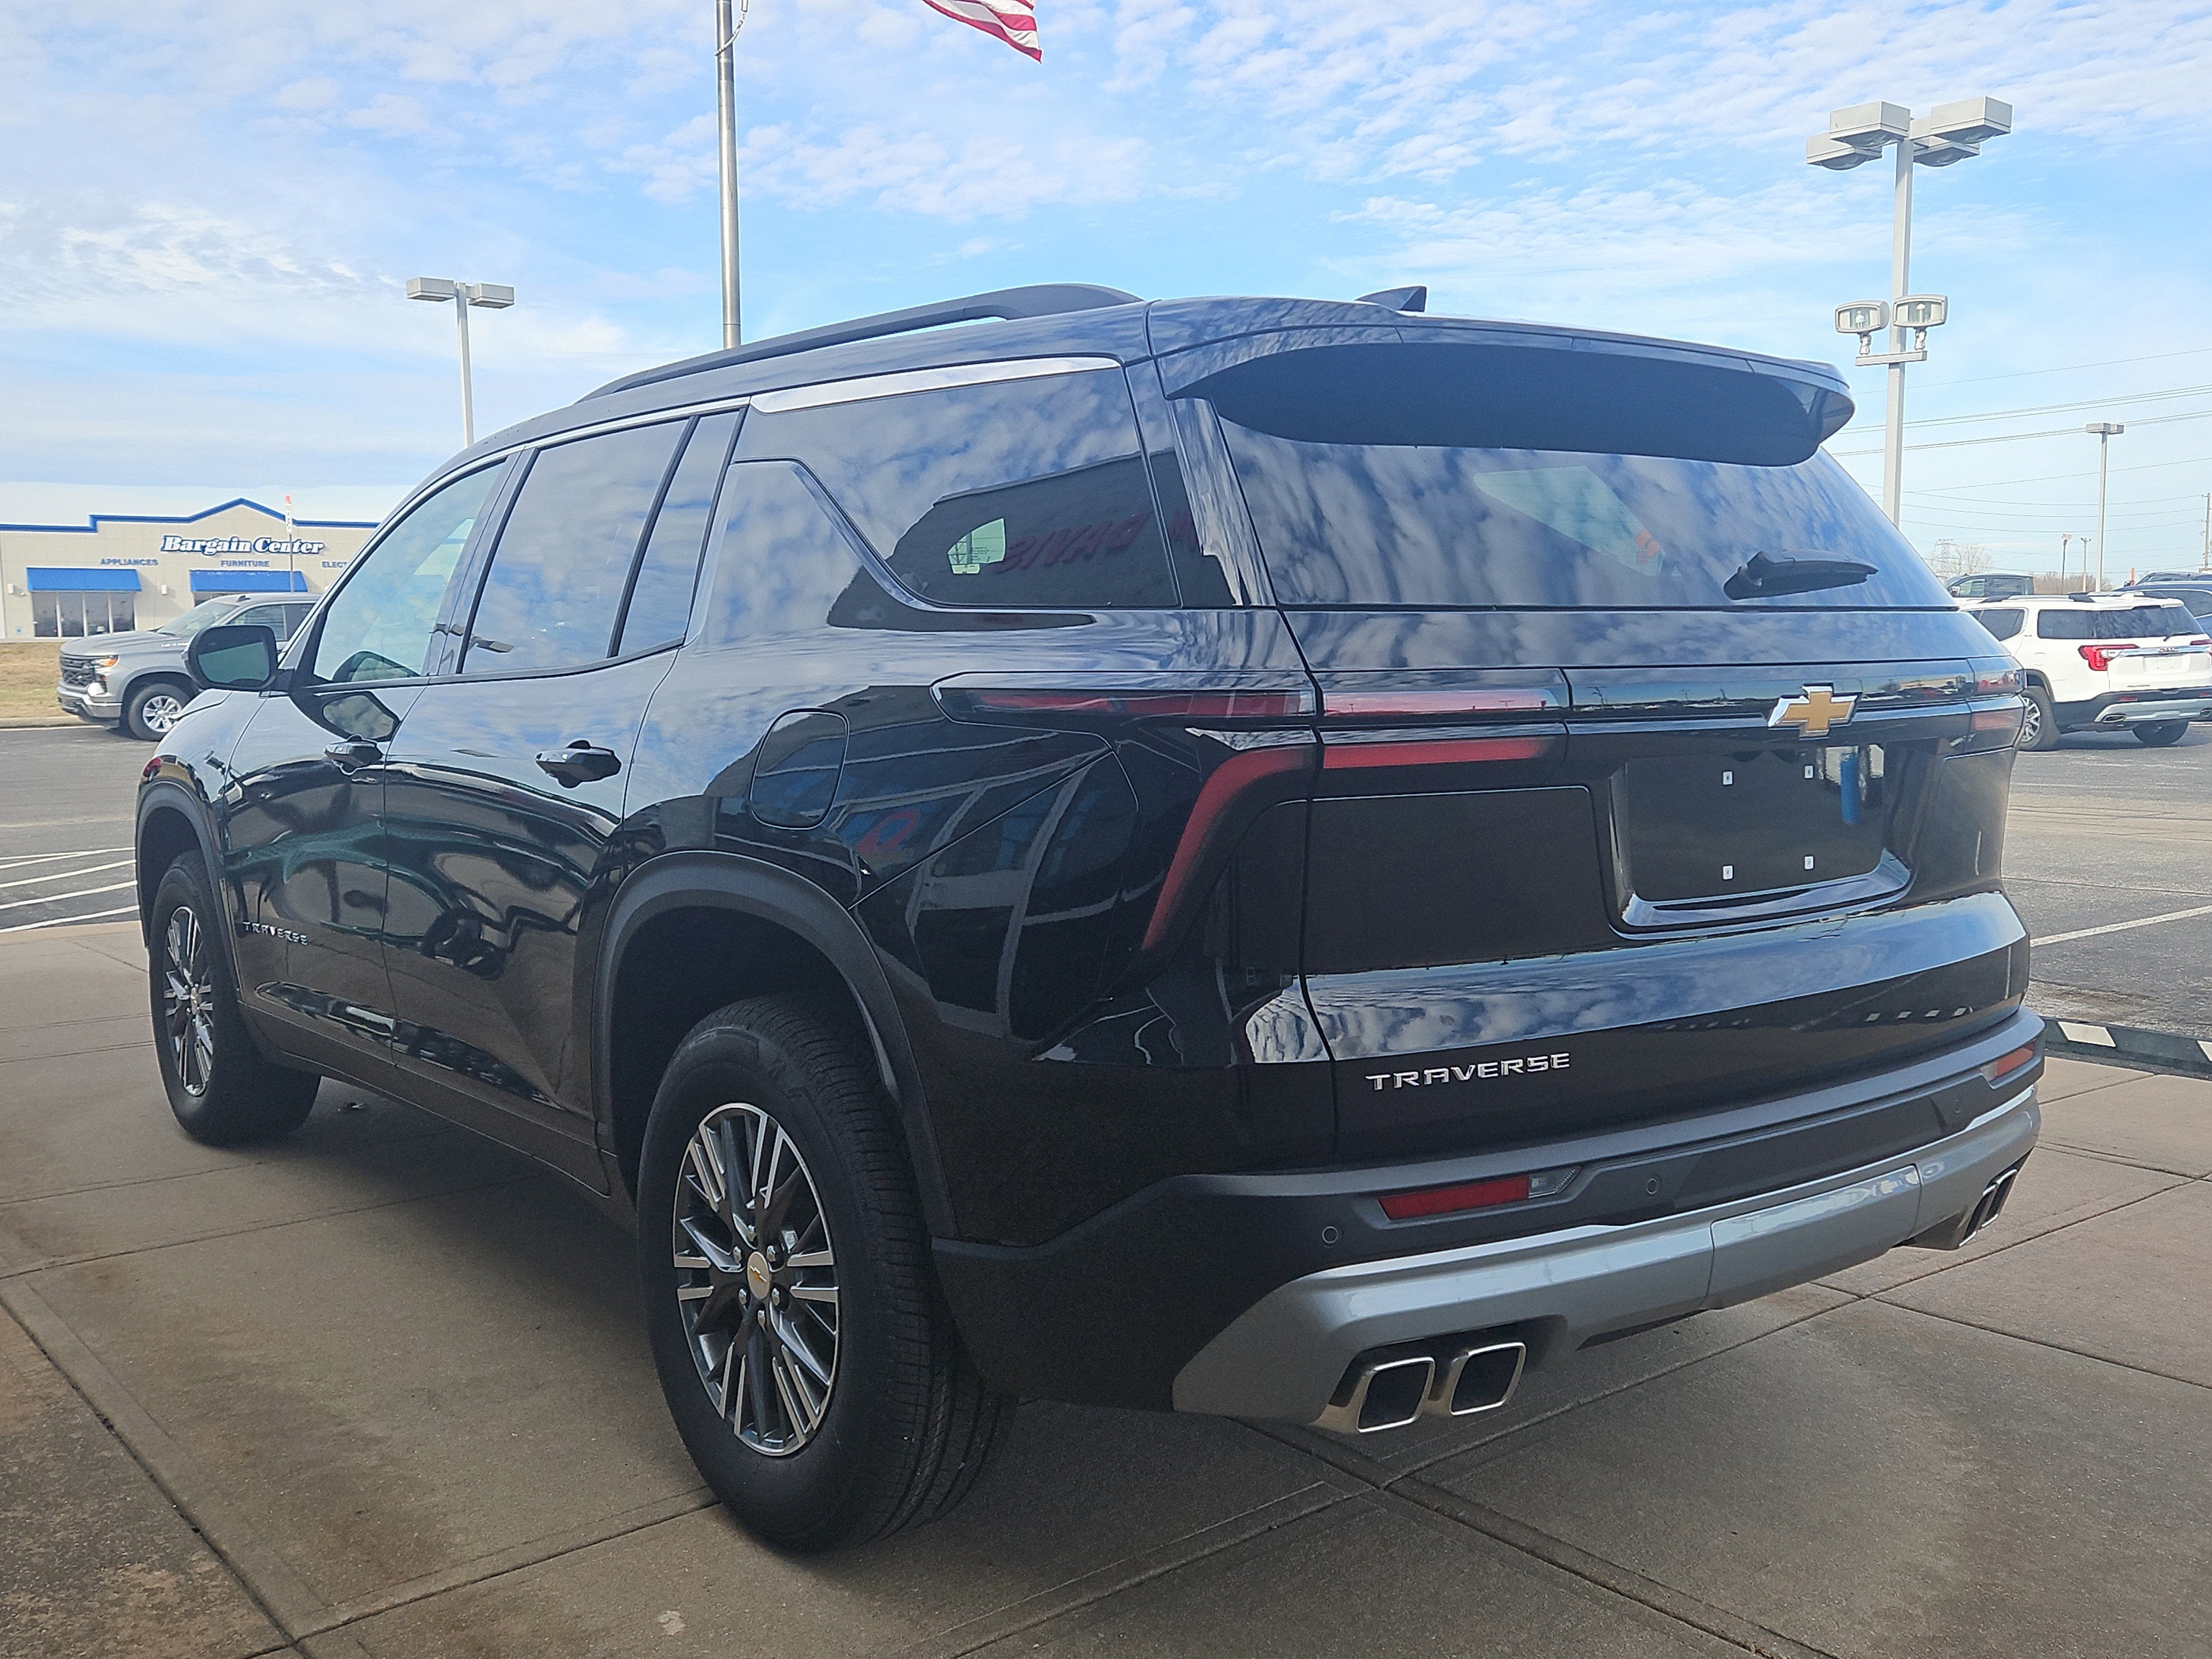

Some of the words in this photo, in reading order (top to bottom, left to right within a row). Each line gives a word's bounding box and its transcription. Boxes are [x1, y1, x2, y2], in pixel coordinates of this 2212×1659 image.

[161, 535, 252, 556] Bargain
[253, 537, 325, 554] Center
[242, 921, 308, 946] TRAVERSE
[1365, 1052, 1571, 1091] TRAVERSE
